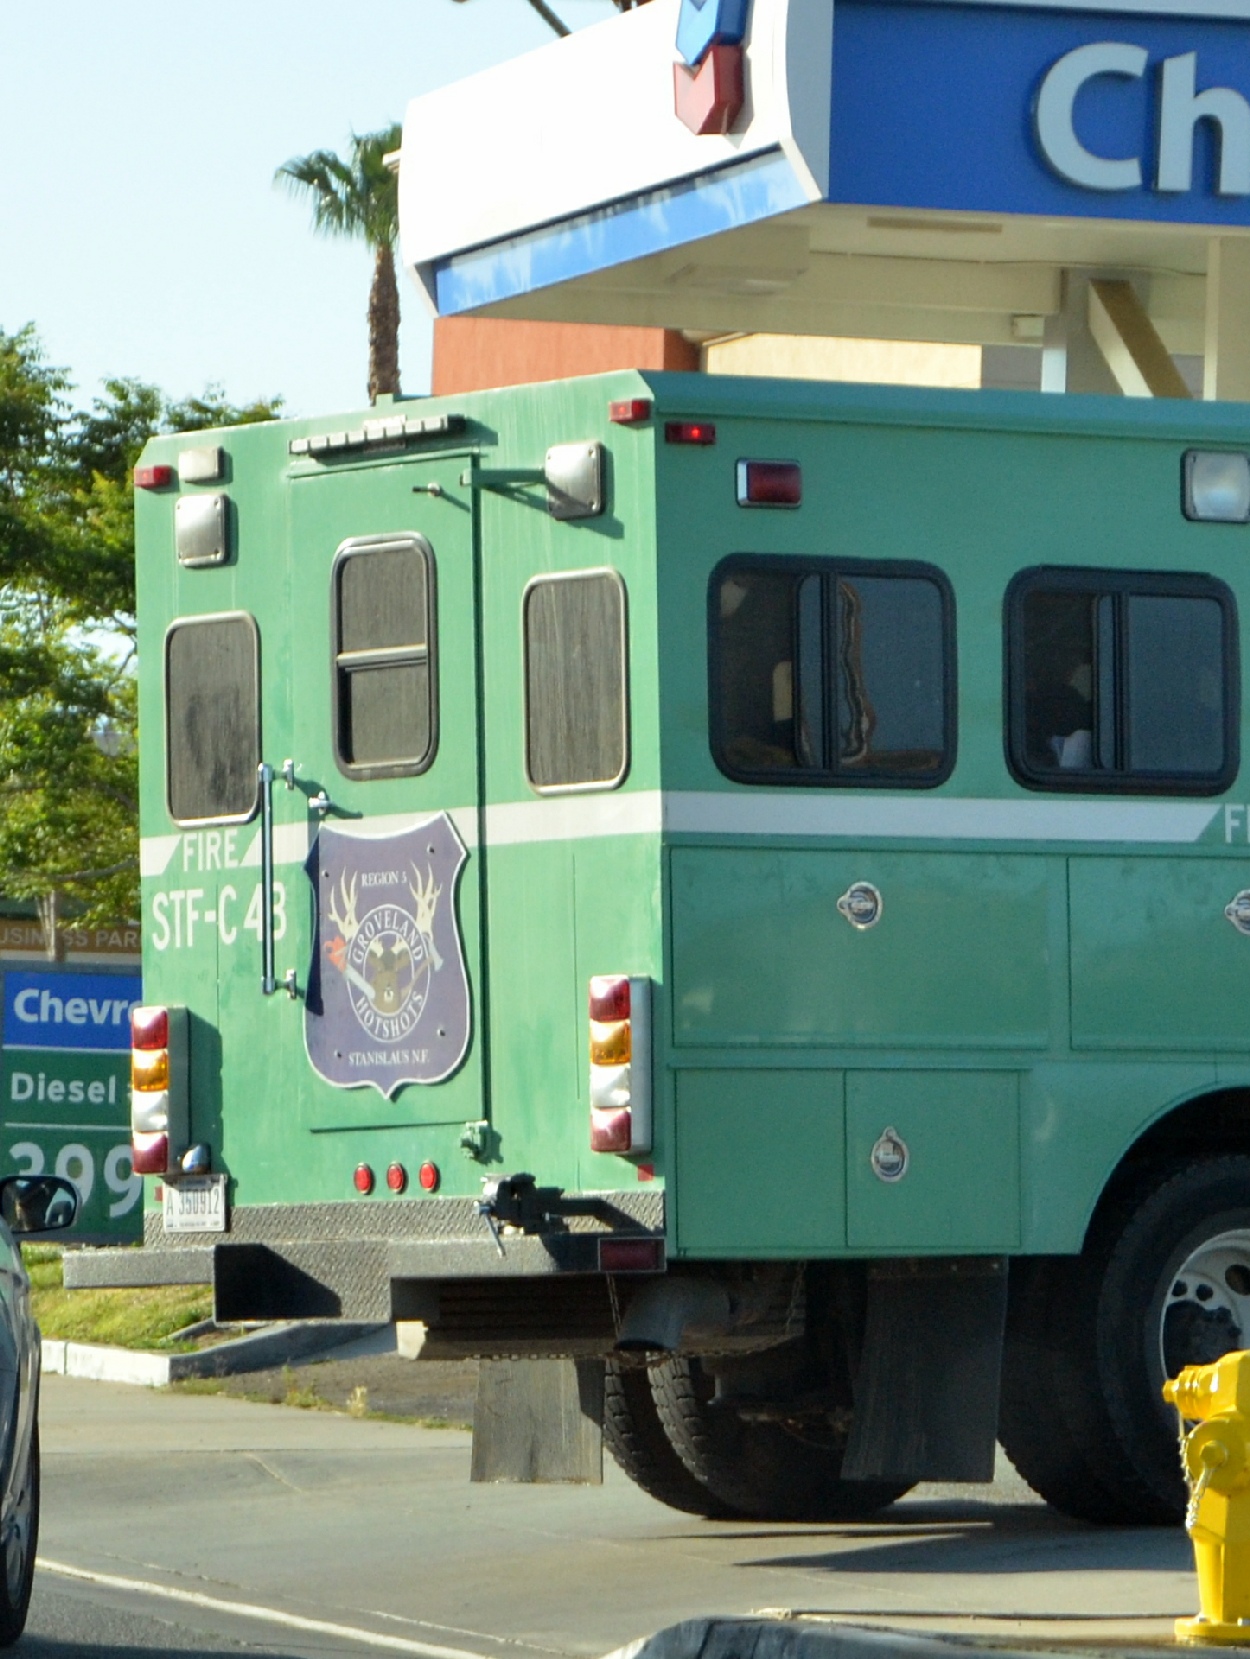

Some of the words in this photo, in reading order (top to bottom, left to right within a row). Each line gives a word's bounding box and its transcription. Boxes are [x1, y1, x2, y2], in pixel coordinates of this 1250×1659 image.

[183, 829, 239, 872] FIRE
[361, 872, 399, 887] REGION
[352, 909, 424, 963] GROVELAND
[356, 991, 423, 1038] HOTSHOTS
[349, 1052, 409, 1066] STANISLAUS
[11, 1072, 116, 1104] Diesel
